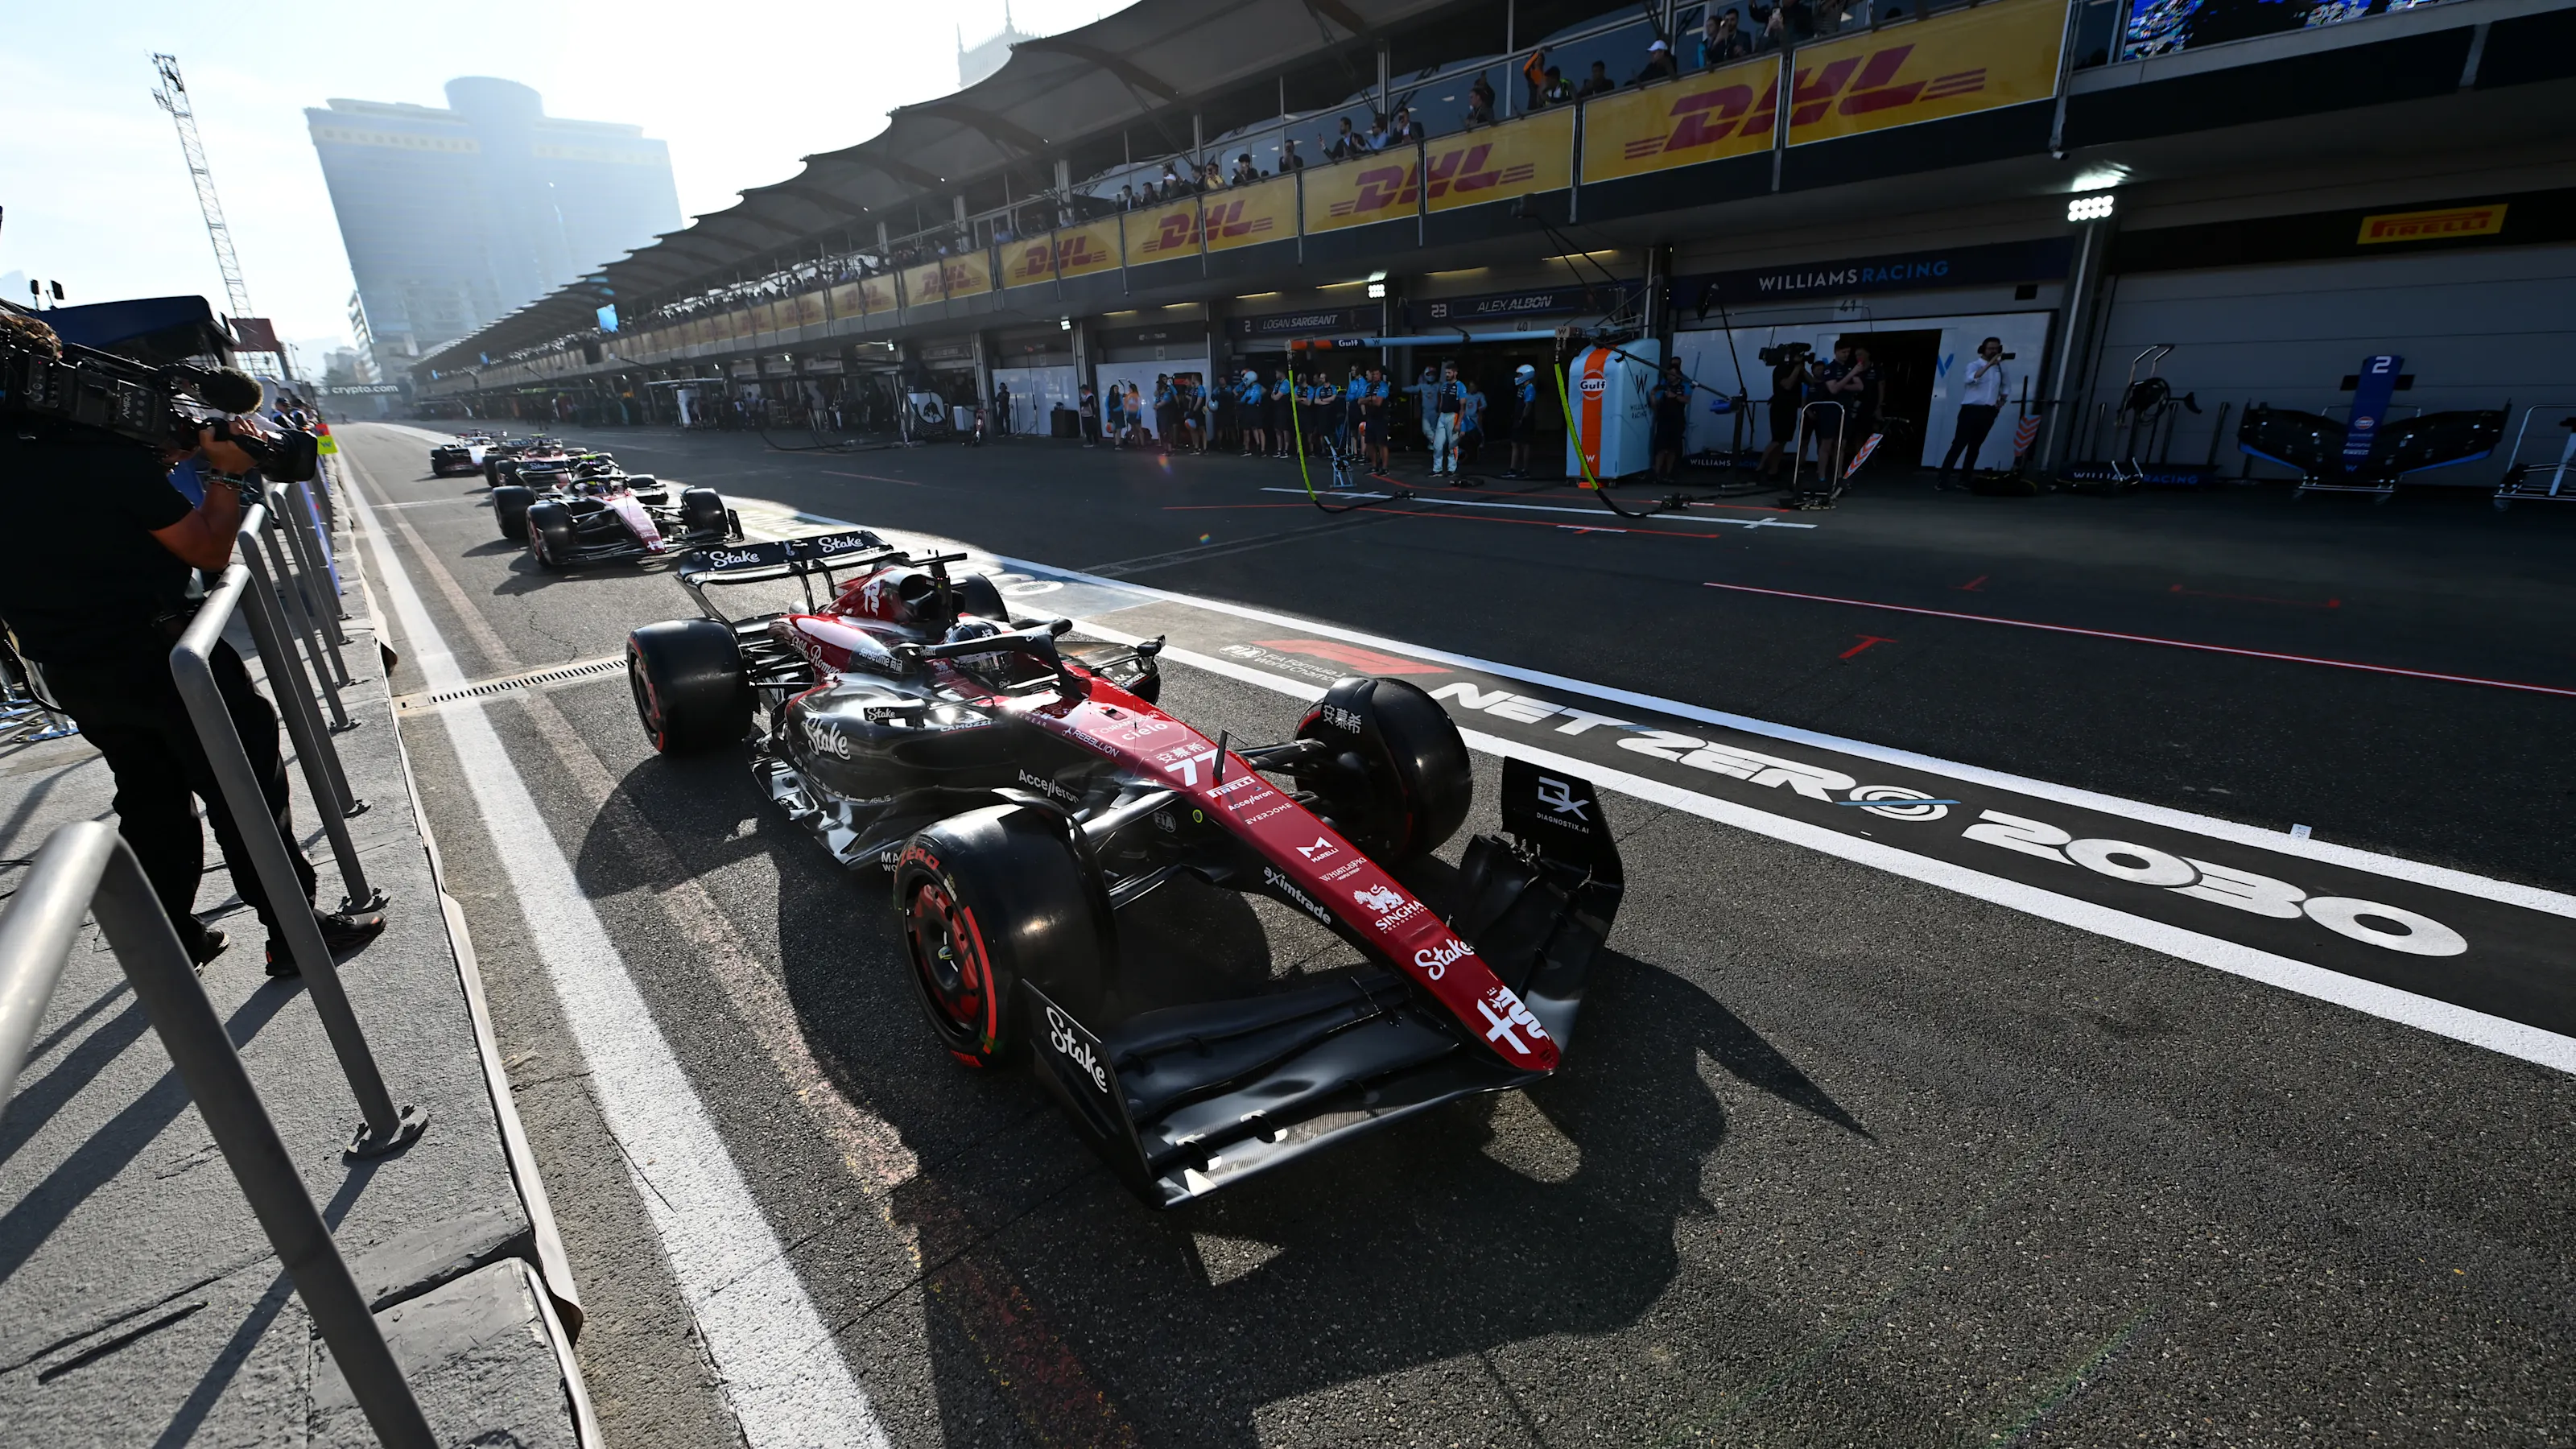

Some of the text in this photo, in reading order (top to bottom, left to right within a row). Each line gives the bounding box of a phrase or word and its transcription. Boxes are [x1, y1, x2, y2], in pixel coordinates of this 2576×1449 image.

[1663, 44, 1927, 153] DHL
[1353, 142, 1502, 213] DHL
[1158, 200, 1256, 250] DHL
[2369, 211, 2493, 237] PIRELLI
[1025, 235, 1093, 276] DHL
[923, 263, 971, 295] DHL
[1758, 260, 1950, 291] WILLIAMS RACING
[1431, 303, 1447, 318] 23
[1476, 295, 1553, 312] ALEX ALBON
[1839, 299, 1856, 312] 41
[1244, 320, 1251, 332] 2
[1262, 314, 1338, 330] LOGAN SARGEANT
[1517, 321, 1529, 332] 40
[1337, 339, 1358, 348] Gulf
[2372, 355, 2392, 374] 2
[331, 384, 399, 395] crypto.com
[1579, 381, 1607, 390] Gulf
[122, 391, 132, 419] AMIRA
[1585, 454, 1596, 463] W
[1690, 457, 1732, 467] WILLIAMS
[2145, 473, 2198, 485] RACING
[817, 535, 864, 554] Stake
[708, 549, 761, 568] Stake
[791, 635, 841, 677] Alfa Romeo
[858, 646, 891, 667] sensetime
[1254, 656, 1290, 670] World
[1264, 653, 1286, 663] FIA
[1285, 658, 1337, 676] Formula
[866, 706, 896, 722] Stake
[1323, 704, 1363, 735] 安慕希
[939, 720, 991, 733] CAMOZZI
[1121, 723, 1168, 741] cielo
[804, 716, 851, 761] Stake
[1072, 729, 1120, 758] REBELLION
[1156, 741, 1207, 764] 安慕希
[1164, 749, 1226, 787] 77
[1018, 767, 1080, 803] Accelleron
[1206, 775, 1257, 798] PIRELLI
[869, 795, 892, 804] AGILIS
[1228, 790, 1274, 811] Accelleron
[1154, 811, 1177, 832] FIA
[1245, 802, 1293, 825] EVERDOME
[1427, 682, 2468, 957] NET ZERO 2030
[1536, 811, 1590, 834] DIAGNOSTIX.AI
[881, 850, 900, 864] MA
[899, 845, 941, 871] ZERO
[1311, 848, 1339, 863] MARELLI
[881, 863, 898, 873] WO
[1319, 857, 1368, 882] WHISTLEPIG
[1263, 865, 1332, 926] aximtrade
[1374, 899, 1425, 932] SINGHA
[1414, 938, 1476, 981] Stake
[1045, 1006, 1108, 1093] Stake
